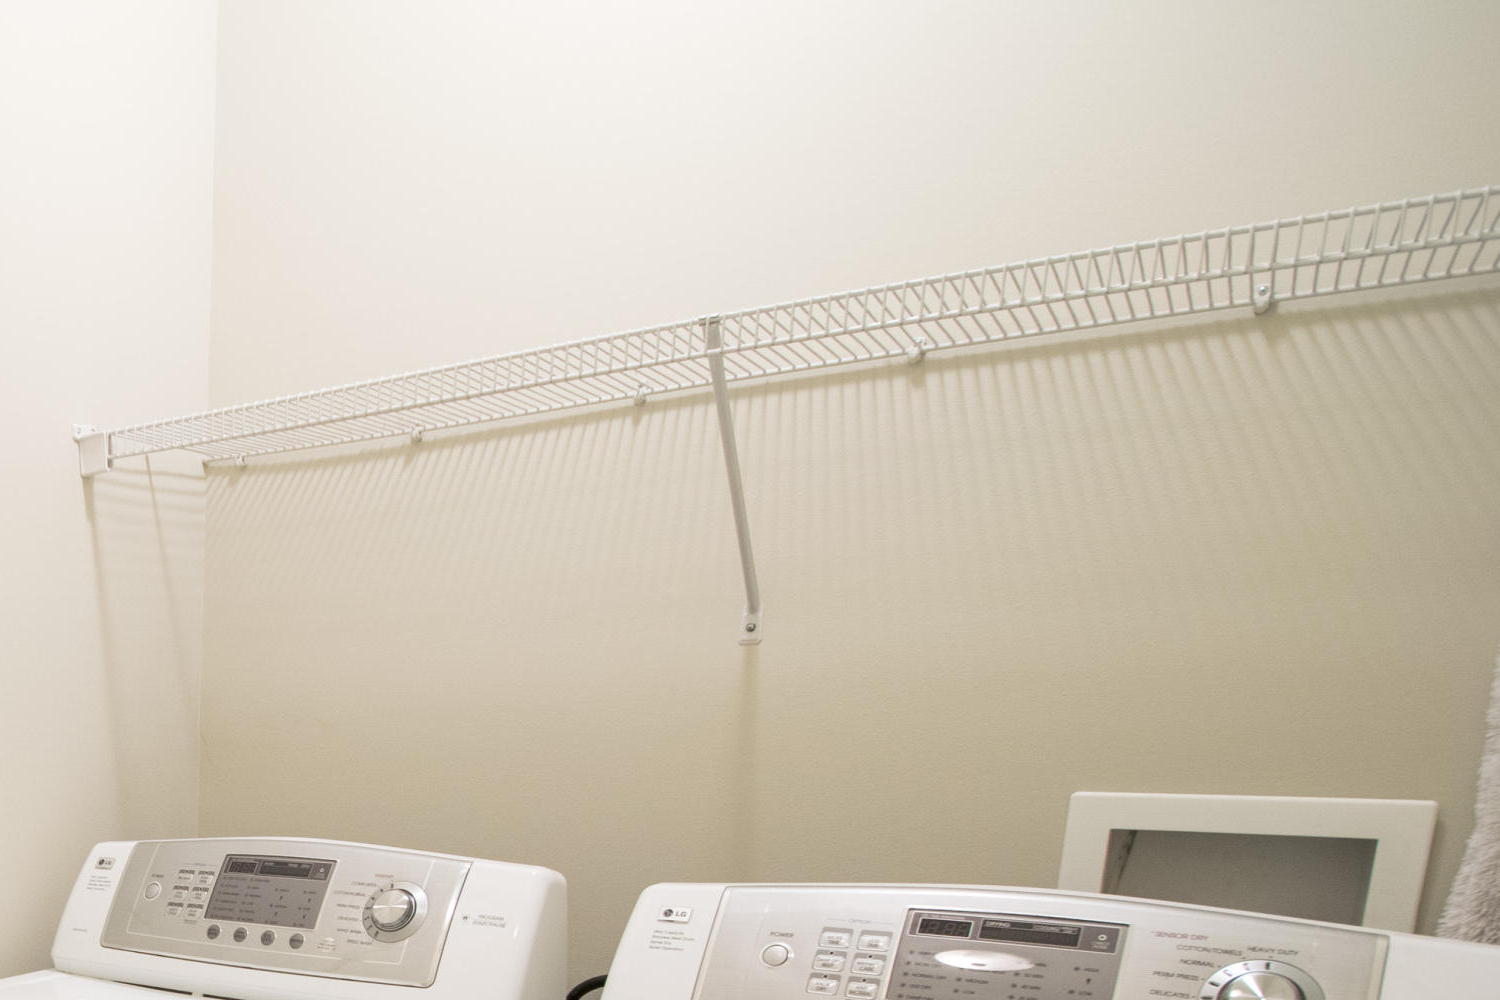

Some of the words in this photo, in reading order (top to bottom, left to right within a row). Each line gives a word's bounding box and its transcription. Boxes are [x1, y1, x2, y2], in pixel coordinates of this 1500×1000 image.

[675, 909, 687, 918] LG
[770, 930, 794, 938] POWER
[1154, 931, 1188, 940] SENSOR
[1190, 934, 1209, 942] DRY
[1176, 944, 1243, 957] COTTON/TOWELS
[1247, 946, 1275, 955] HEAVY
[1277, 948, 1299, 957] DUTY
[1180, 958, 1215, 968] NORMAL
[1153, 970, 1176, 979] PERM
[1176, 973, 1199, 982] PRESS
[1149, 989, 1191, 1000] DELICATES
